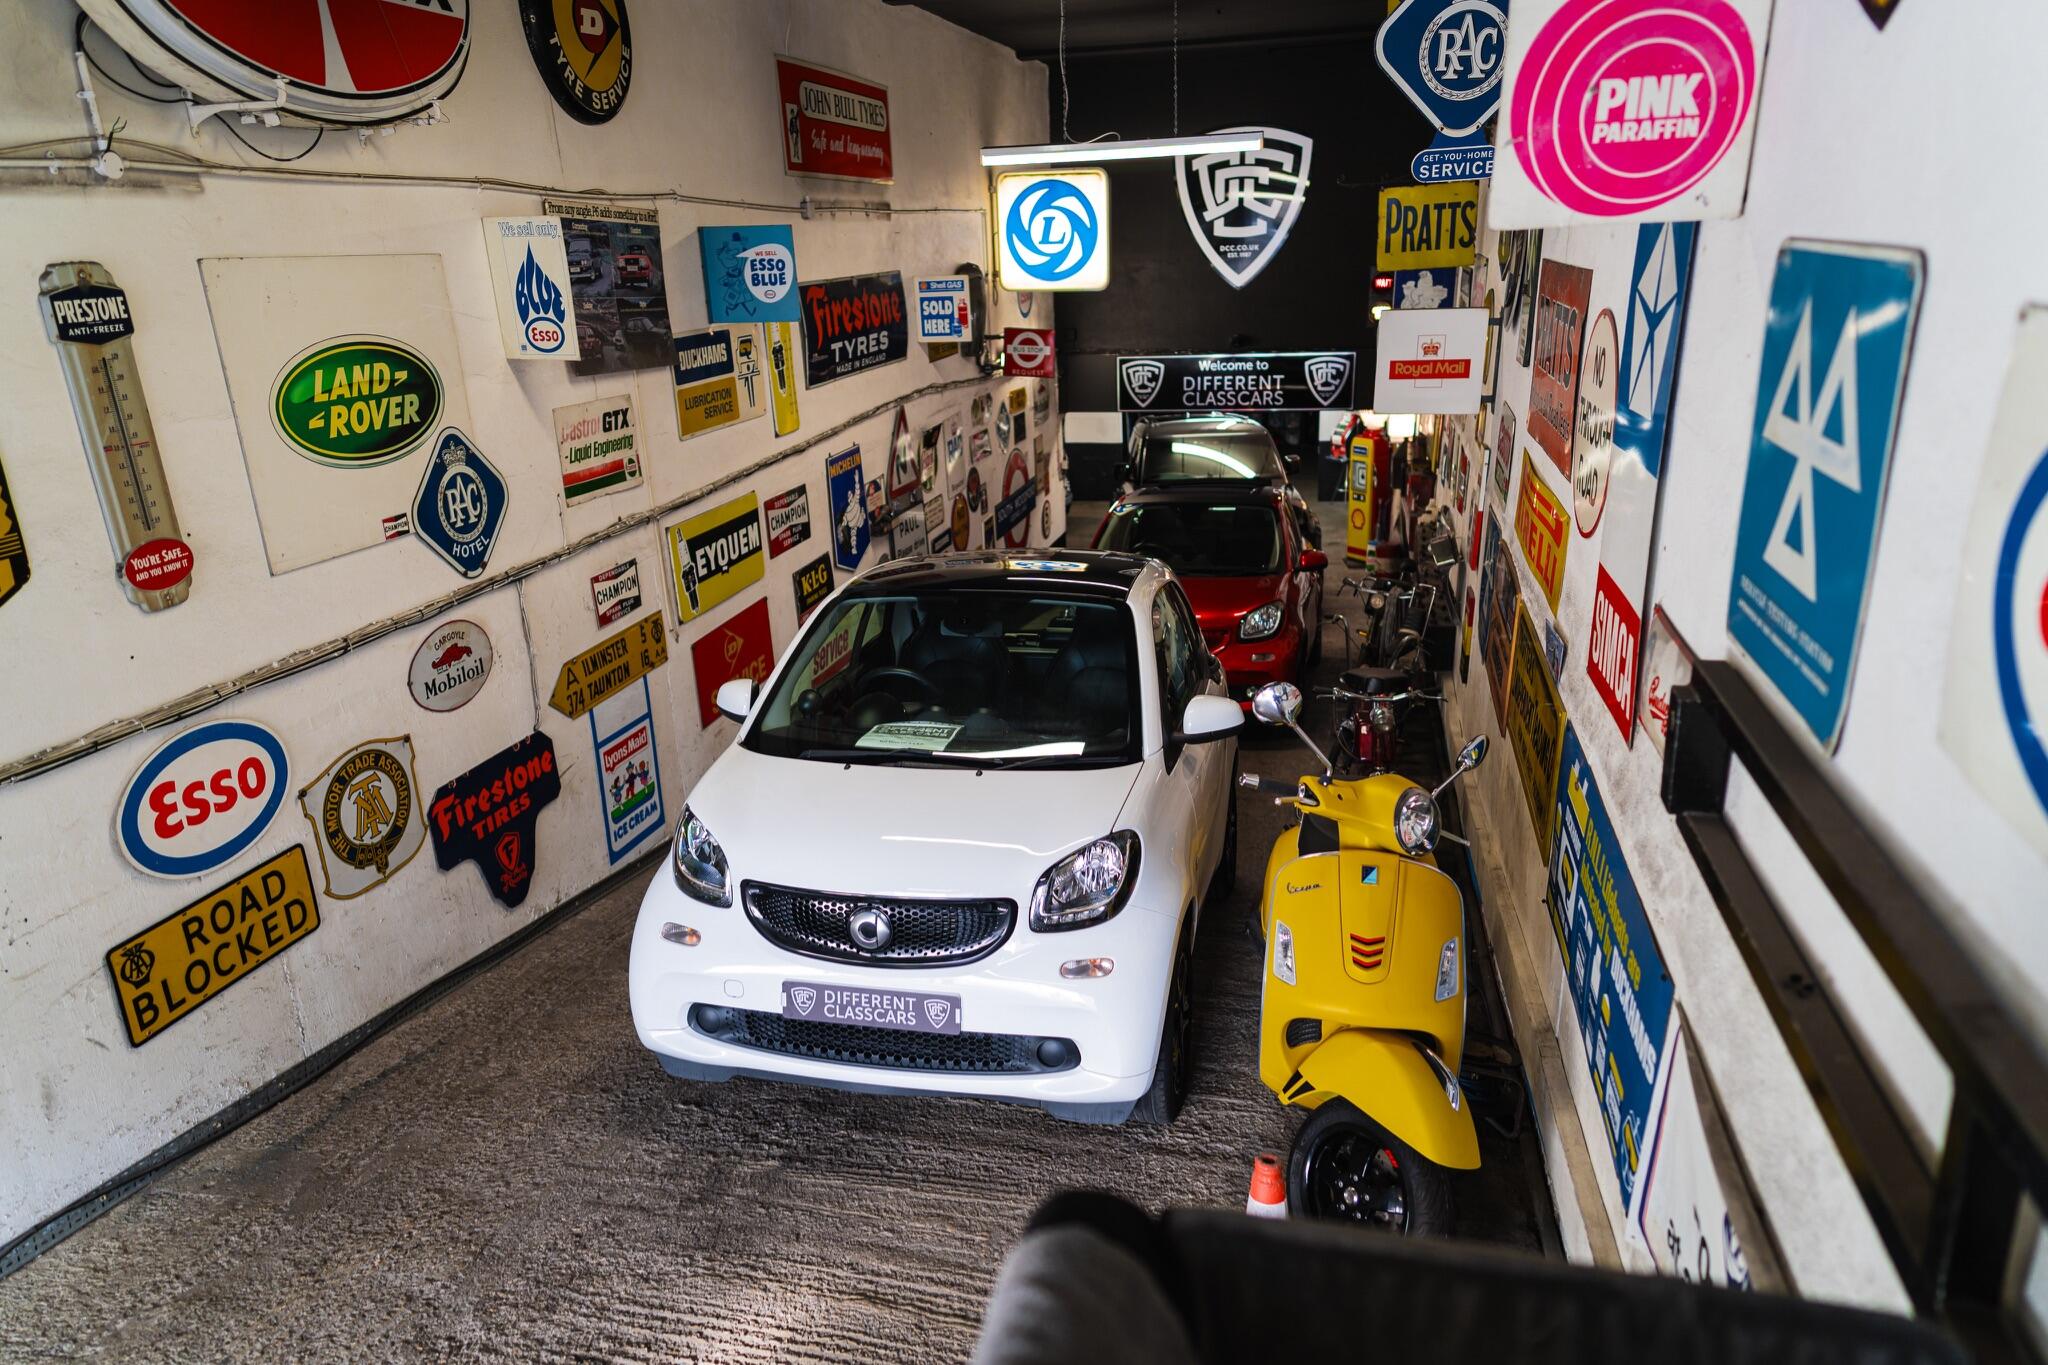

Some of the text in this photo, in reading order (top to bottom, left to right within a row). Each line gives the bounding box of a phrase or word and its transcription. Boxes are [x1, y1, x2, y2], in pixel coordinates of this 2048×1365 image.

[1435, 13, 1498, 79] RAC
[549, 31, 631, 110] TYRE SERVICE
[804, 87, 885, 127] JOHN BULL TYRES
[1595, 73, 1704, 122] PINK
[1592, 117, 1700, 145] PARAFFIN
[1419, 160, 1493, 178] SERVICE
[1423, 151, 1493, 163] GET-YOU-HOME
[548, 201, 564, 214] From
[564, 205, 575, 217] any
[600, 207, 613, 218] adds
[613, 209, 638, 223] something
[1385, 197, 1476, 253] PRATTS
[498, 221, 515, 236] We
[516, 221, 535, 236] sell
[1038, 216, 1066, 245] L
[750, 258, 786, 272] ESSO
[751, 272, 787, 287] BLUE
[516, 241, 565, 325] BLUE
[53, 296, 128, 325] PRESTONE
[806, 286, 901, 350] Firestone
[922, 300, 953, 315] SOLD
[68, 323, 125, 337] ANTI-FREEZE
[924, 319, 950, 334] HERE
[679, 343, 727, 371] DUCKHAMS
[831, 330, 889, 362] TYRES
[836, 353, 887, 373] MADE IN ENGLAND
[1199, 361, 1269, 372] Welcome to
[1395, 362, 1465, 377] Royal Mail
[1592, 344, 1606, 390] NO
[1183, 375, 1285, 391] DIFFERENT
[684, 387, 733, 411] LUBRICATION
[704, 401, 733, 420] SERVICE
[1182, 391, 1284, 406] CLASSCARS
[602, 408, 630, 433] GTX
[569, 434, 634, 464] Liquid Engineering
[445, 475, 481, 528] RAC
[771, 501, 806, 531] CHAMPION
[384, 520, 409, 533] CHAMPION
[452, 535, 490, 558] HOTEL
[696, 522, 760, 578] EYQUEM
[136, 559, 188, 582] AND YOU KNOW IT
[596, 574, 637, 606] CHAMPION
[434, 631, 465, 651] GARGOYLE
[1592, 590, 1635, 721] SIMCA
[581, 637, 629, 677] ILMINSTER
[424, 657, 485, 700] Mobiloil
[566, 667, 579, 690] A
[587, 649, 650, 700] TAUNTON 16
[566, 688, 585, 716] 374
[604, 732, 647, 768] Lyons Maid
[327, 753, 408, 858] THE MOTOR TRADE ASSOCIATION
[431, 750, 552, 843] Firestone
[472, 792, 531, 841] TIRES
[613, 800, 658, 842] ICE CREAM
[181, 869, 286, 954] ROAD
[132, 898, 308, 1033] BLOCKED
[823, 1004, 917, 1025] CLASSCARS
[824, 990, 917, 1011] DIFFERENT
[1611, 944, 1657, 1085] DUCKHAMS
